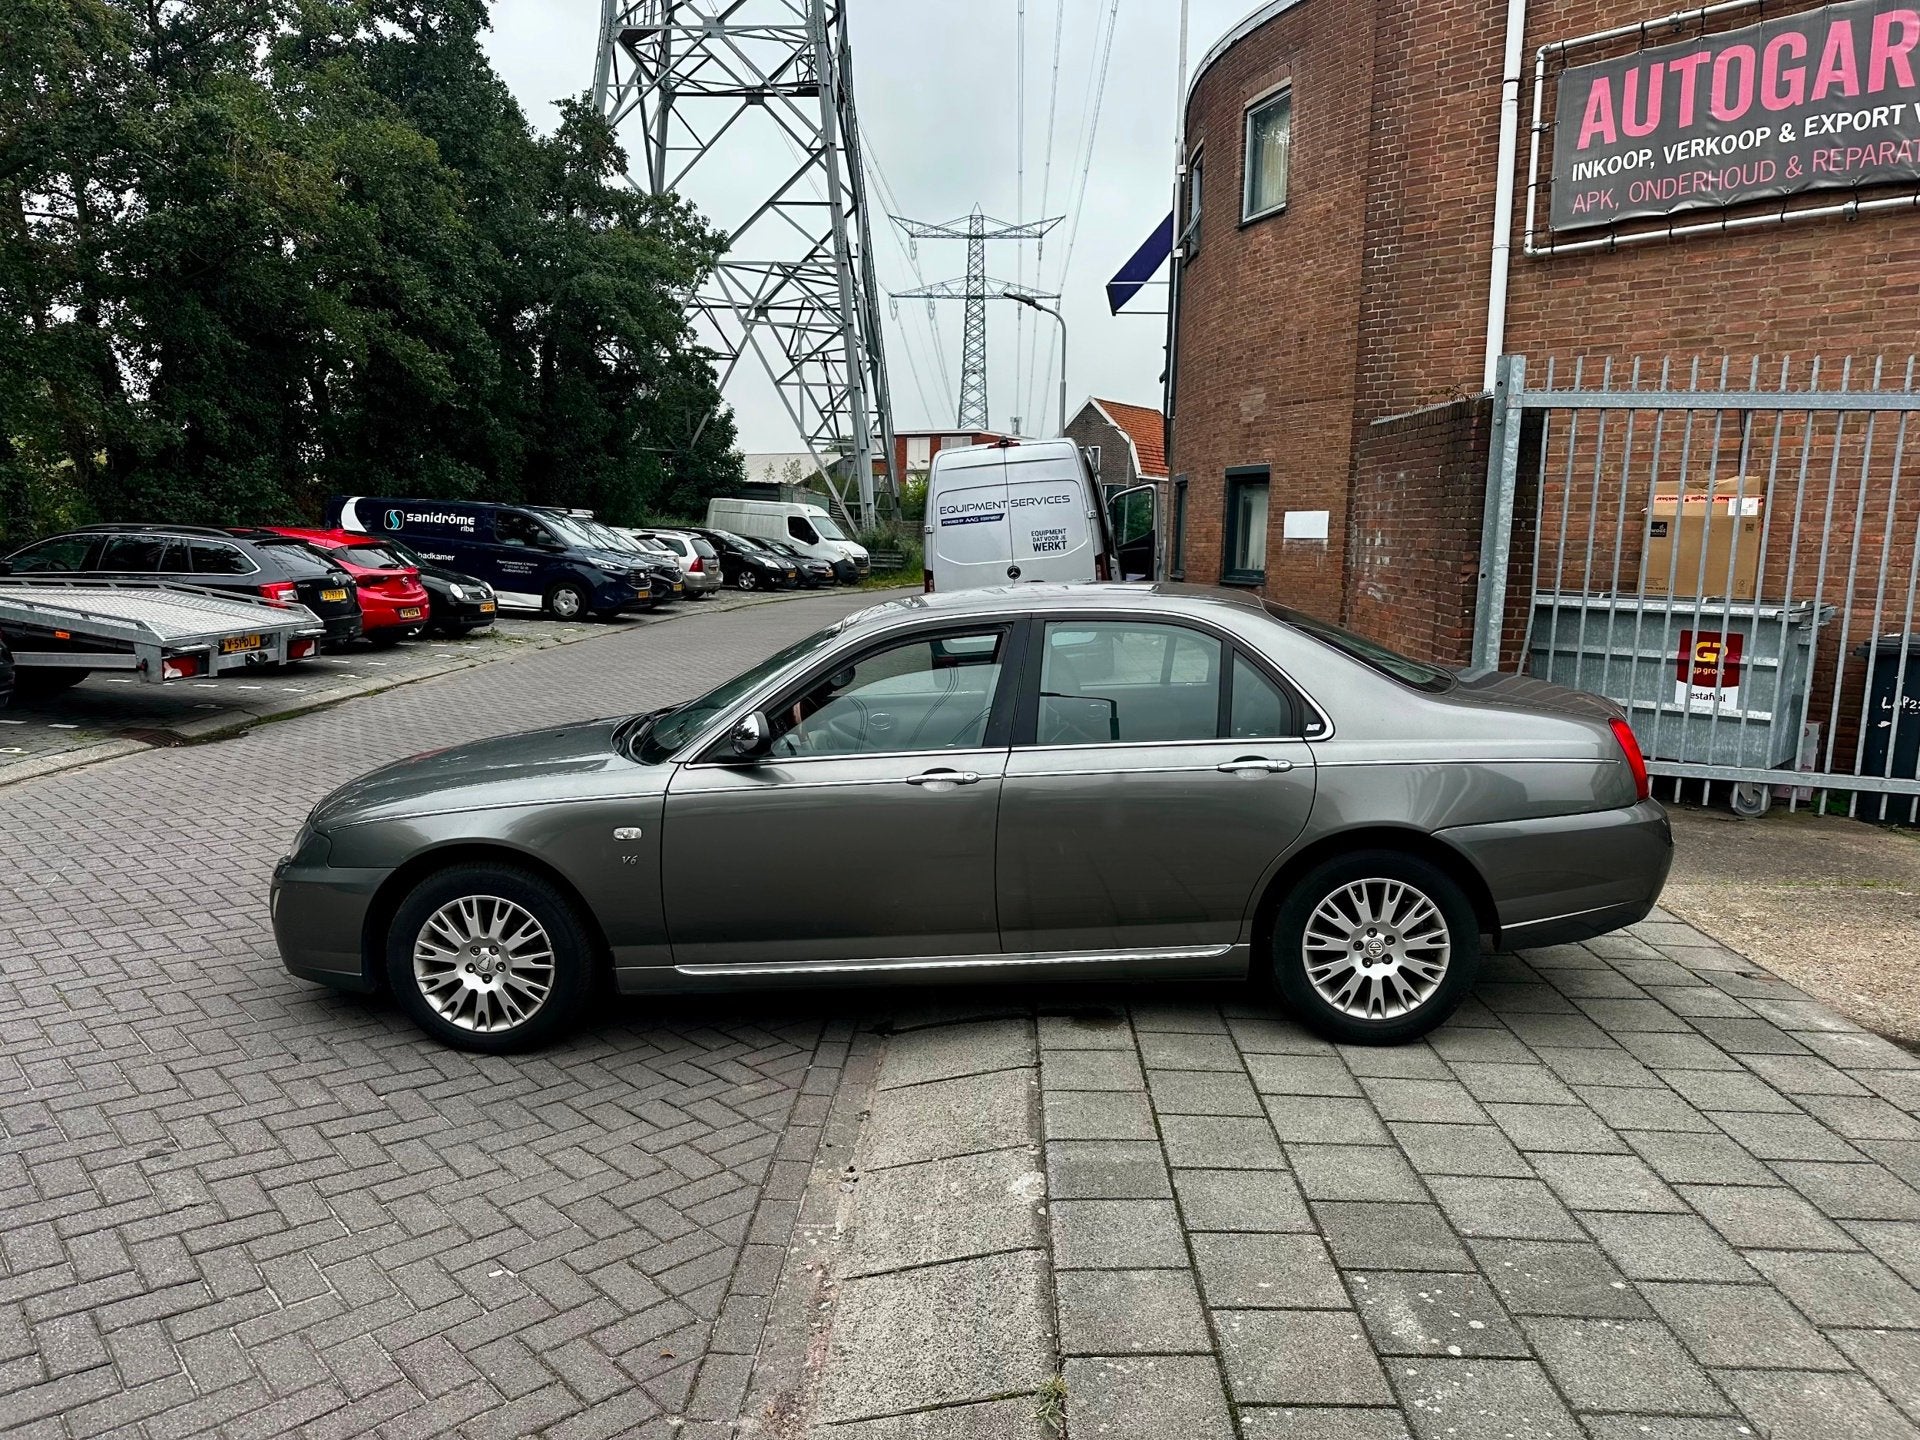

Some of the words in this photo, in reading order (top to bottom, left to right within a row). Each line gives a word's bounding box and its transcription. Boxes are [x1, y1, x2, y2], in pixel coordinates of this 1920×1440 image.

[1577, 9, 1920, 150] AUTOGAR
[1572, 149, 1655, 182] INKOOP,
[1663, 127, 1771, 164] VERKOOP
[1778, 122, 1796, 143] &
[1804, 104, 1906, 138] EXPORT
[1572, 193, 1620, 214] APK,
[1628, 161, 1776, 203] ONDERHOUD
[1785, 155, 1803, 179] &
[940, 501, 1007, 514] EQUIPMENT
[1010, 495, 1070, 507] SERVICES
[1031, 528, 1067, 536] EQUIPMENT
[1033, 541, 1067, 552] WERKT
[622, 854, 638, 865] V6
